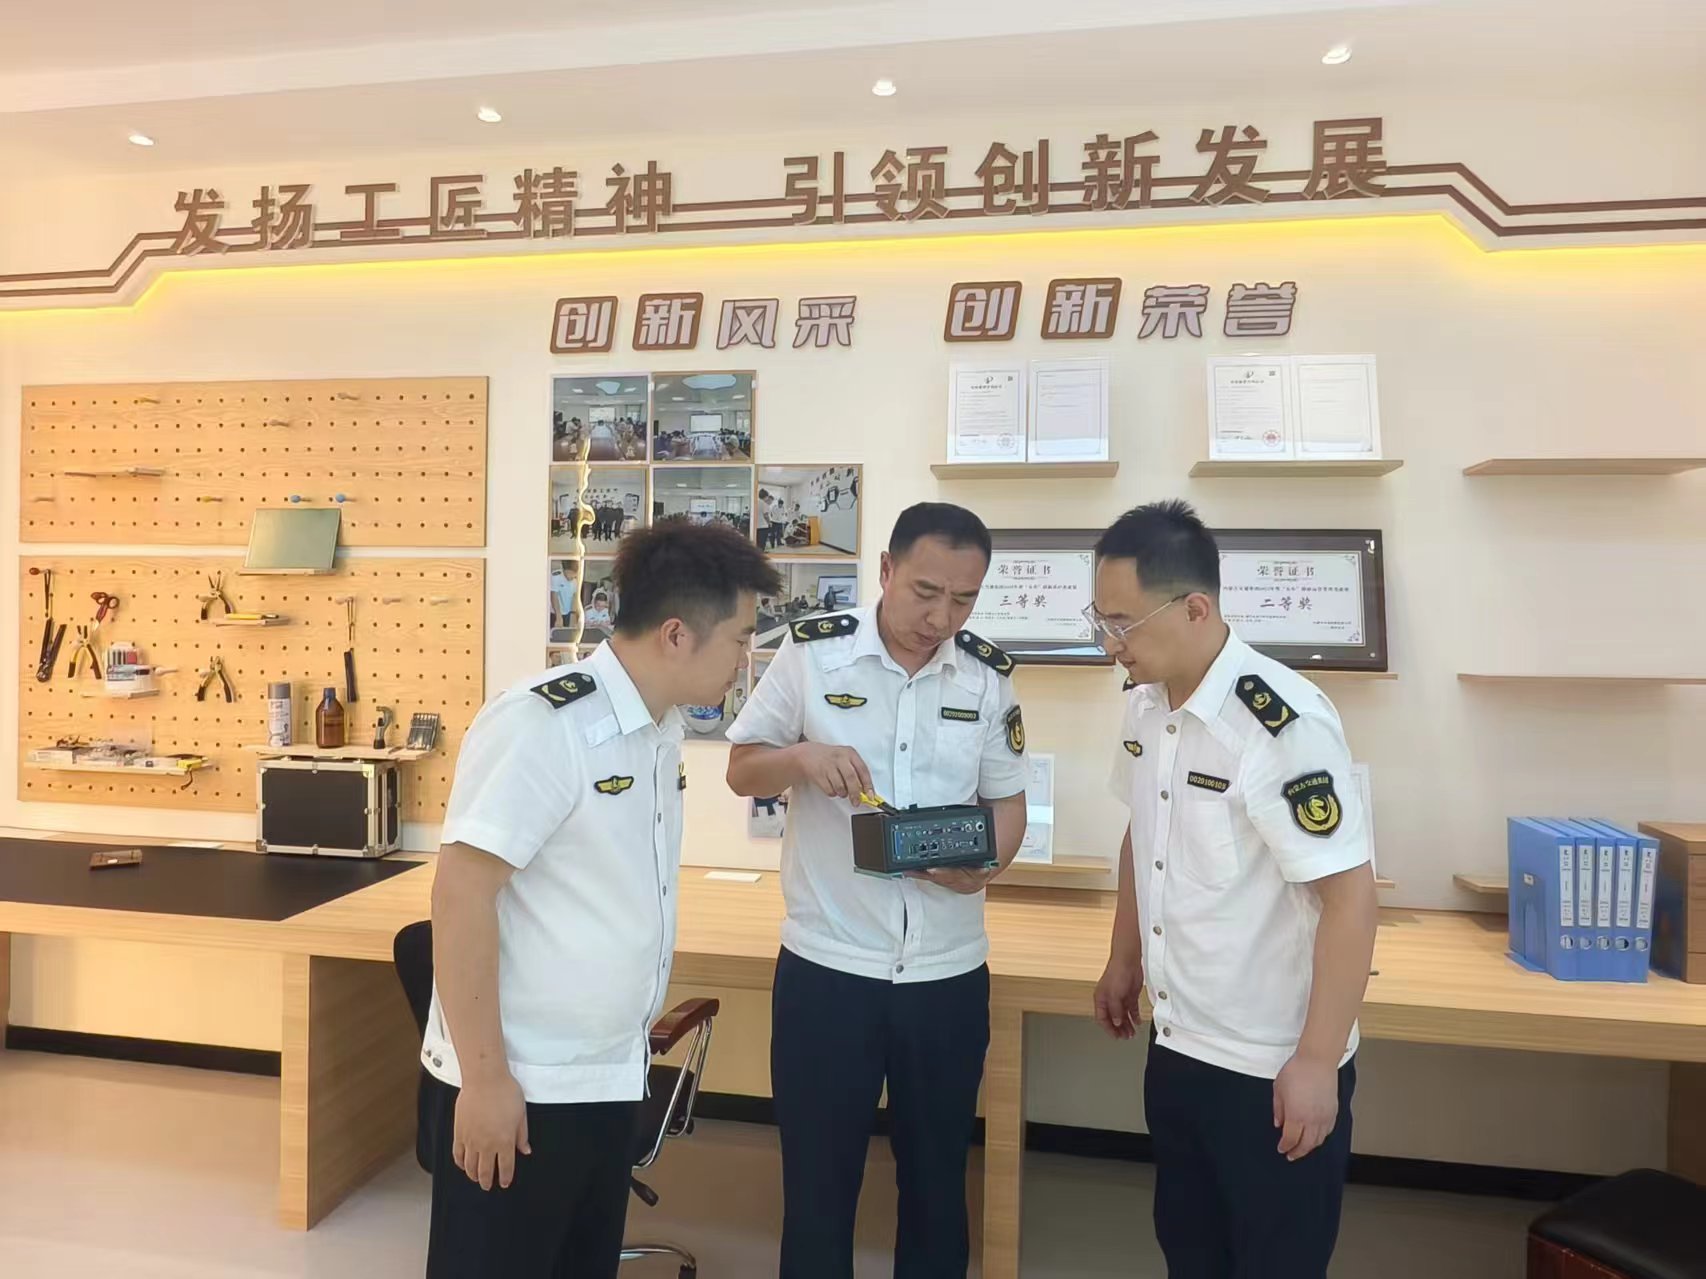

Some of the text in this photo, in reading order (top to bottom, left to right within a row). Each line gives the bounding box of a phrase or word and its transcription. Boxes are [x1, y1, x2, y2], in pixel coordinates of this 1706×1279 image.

[169, 116, 1388, 256] 发扬工匠精神 引领创新发展
[943, 276, 1298, 343] 创新荣誉
[549, 291, 858, 354] 创新风采
[998, 563, 1052, 576] 荣誉证书
[1257, 564, 1315, 577] 荣誉证书
[999, 593, 1048, 609] 三等奖
[1259, 596, 1313, 612] 二等奖
